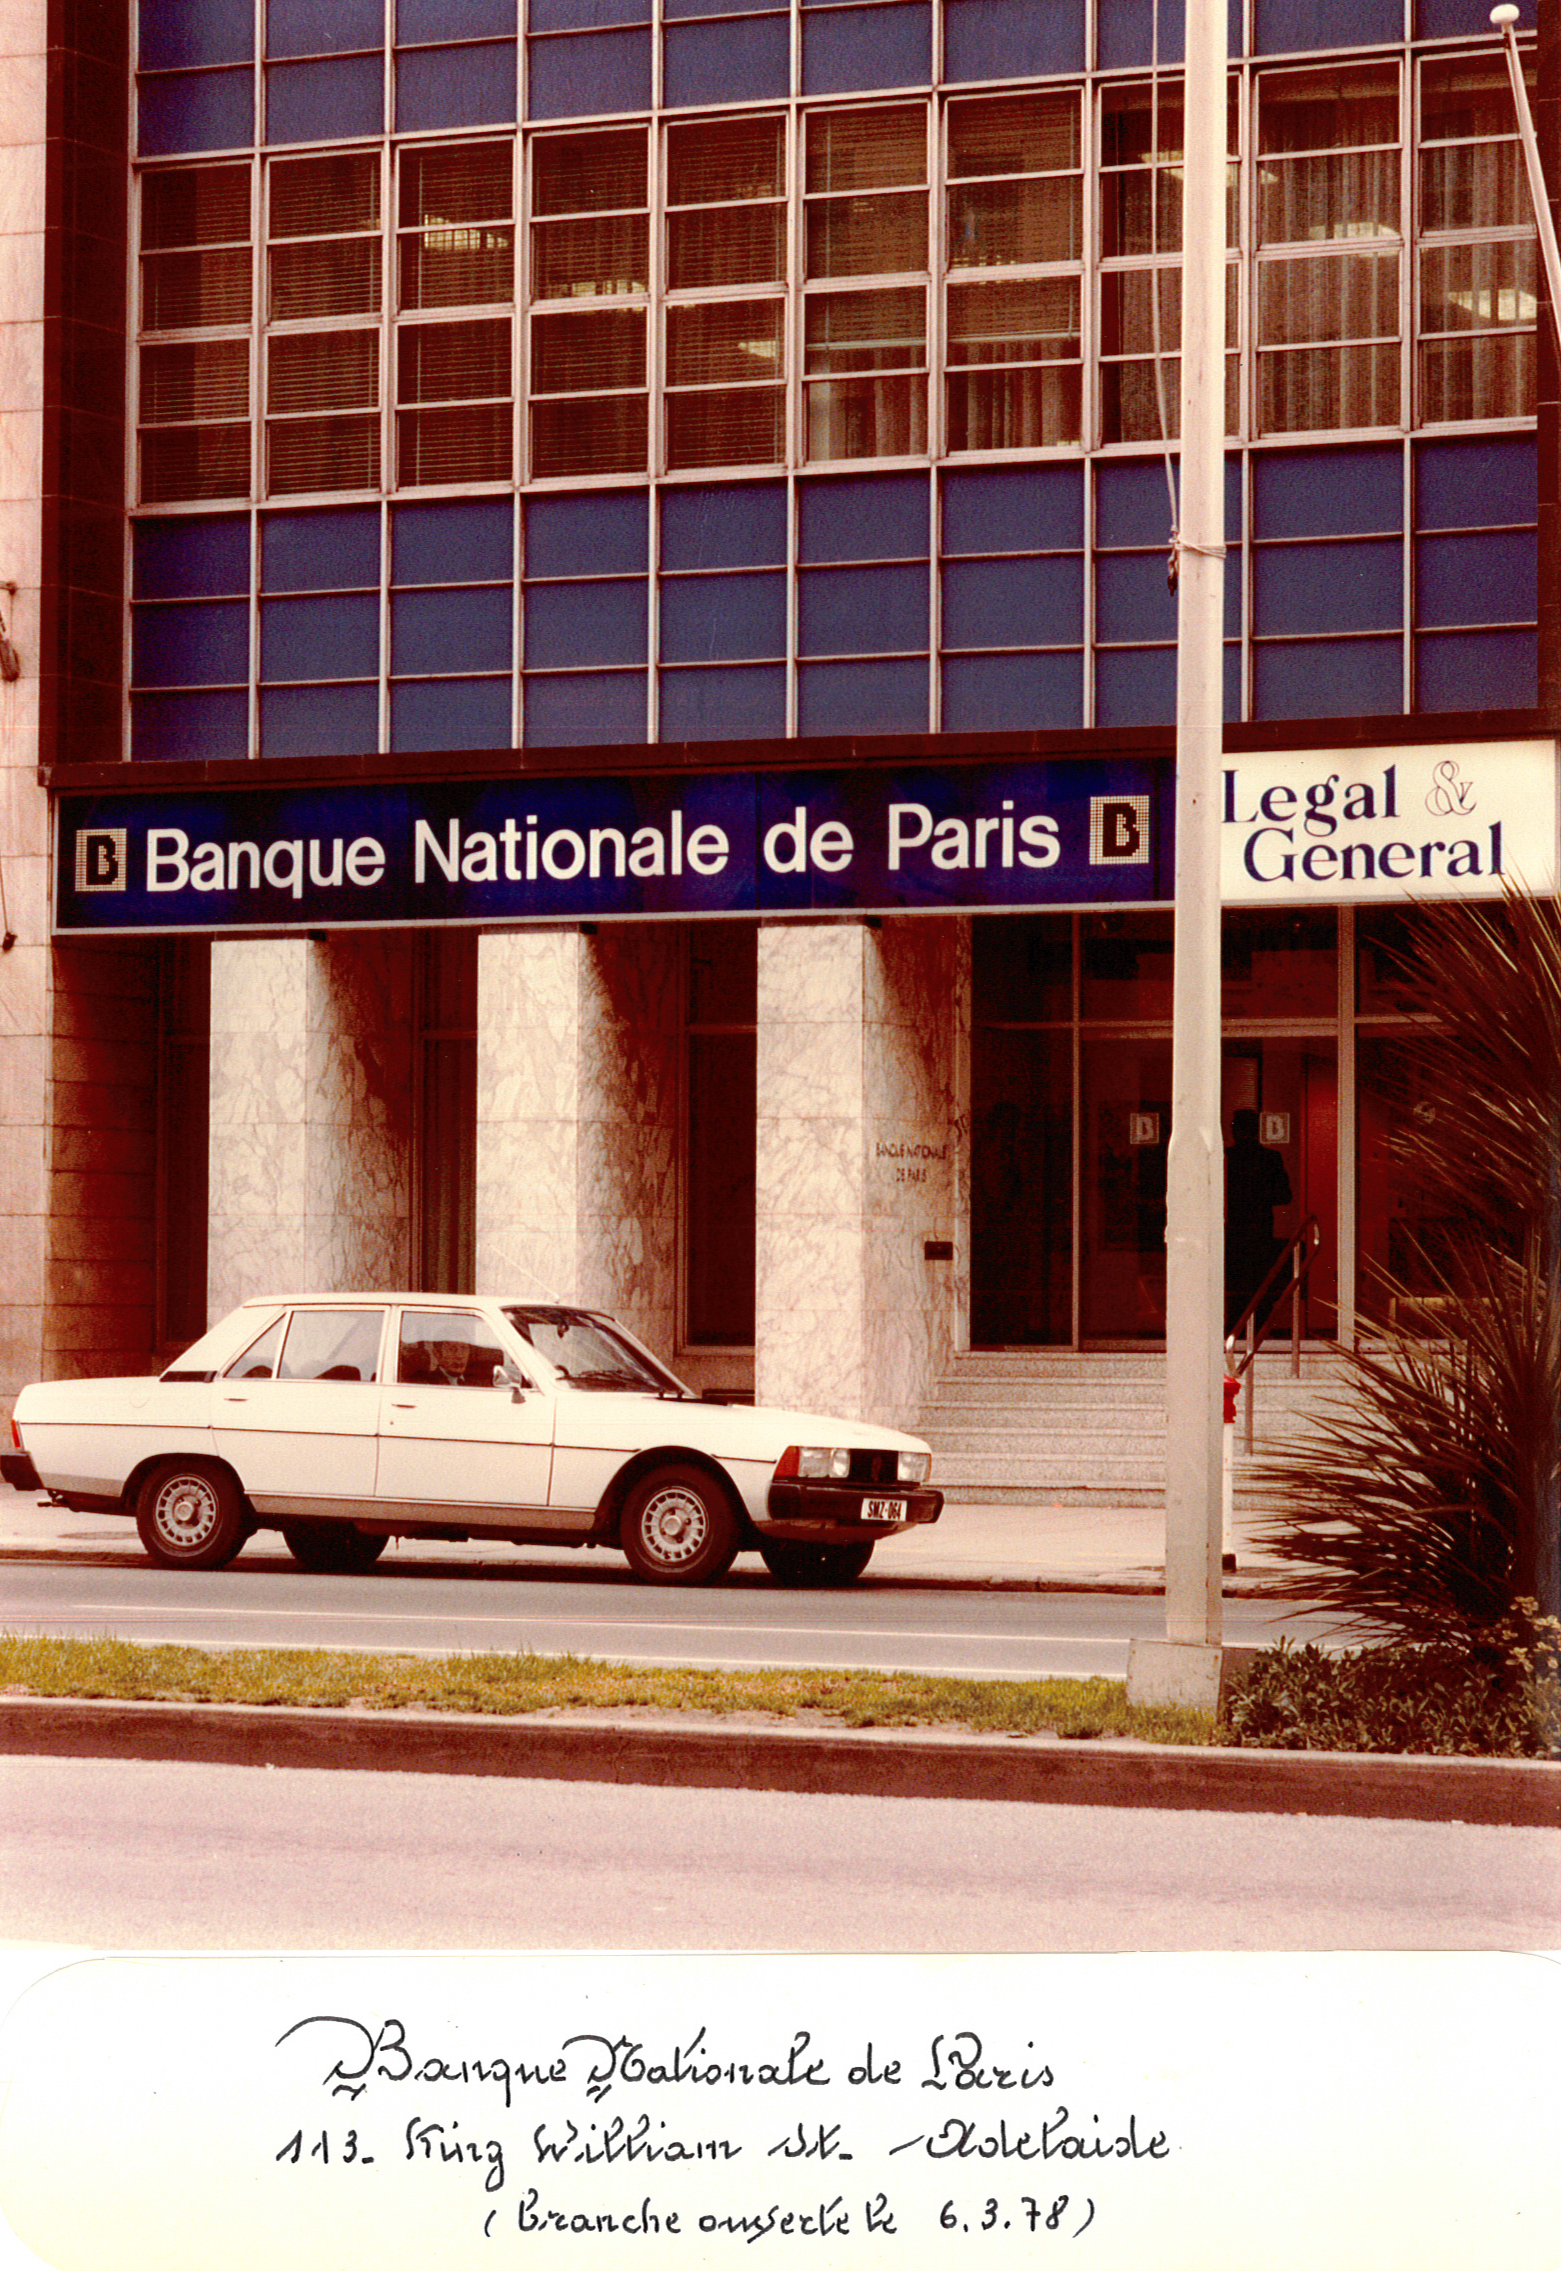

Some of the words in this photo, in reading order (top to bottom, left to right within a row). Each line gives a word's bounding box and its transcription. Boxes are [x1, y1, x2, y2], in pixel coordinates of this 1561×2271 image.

[1222, 763, 1401, 838] Legal
[1424, 760, 1478, 816] &
[145, 827, 386, 900] Banque
[414, 809, 730, 884] Nationale
[763, 806, 855, 874] de
[887, 799, 1061, 870] Paris
[1243, 820, 1507, 883] General
[275, 2015, 567, 2109] Banque
[562, 2026, 830, 2103] Nationale
[848, 2041, 902, 2086] de
[921, 2031, 1055, 2091] Paris
[406, 2116, 505, 2193] King
[533, 2113, 743, 2164] William
